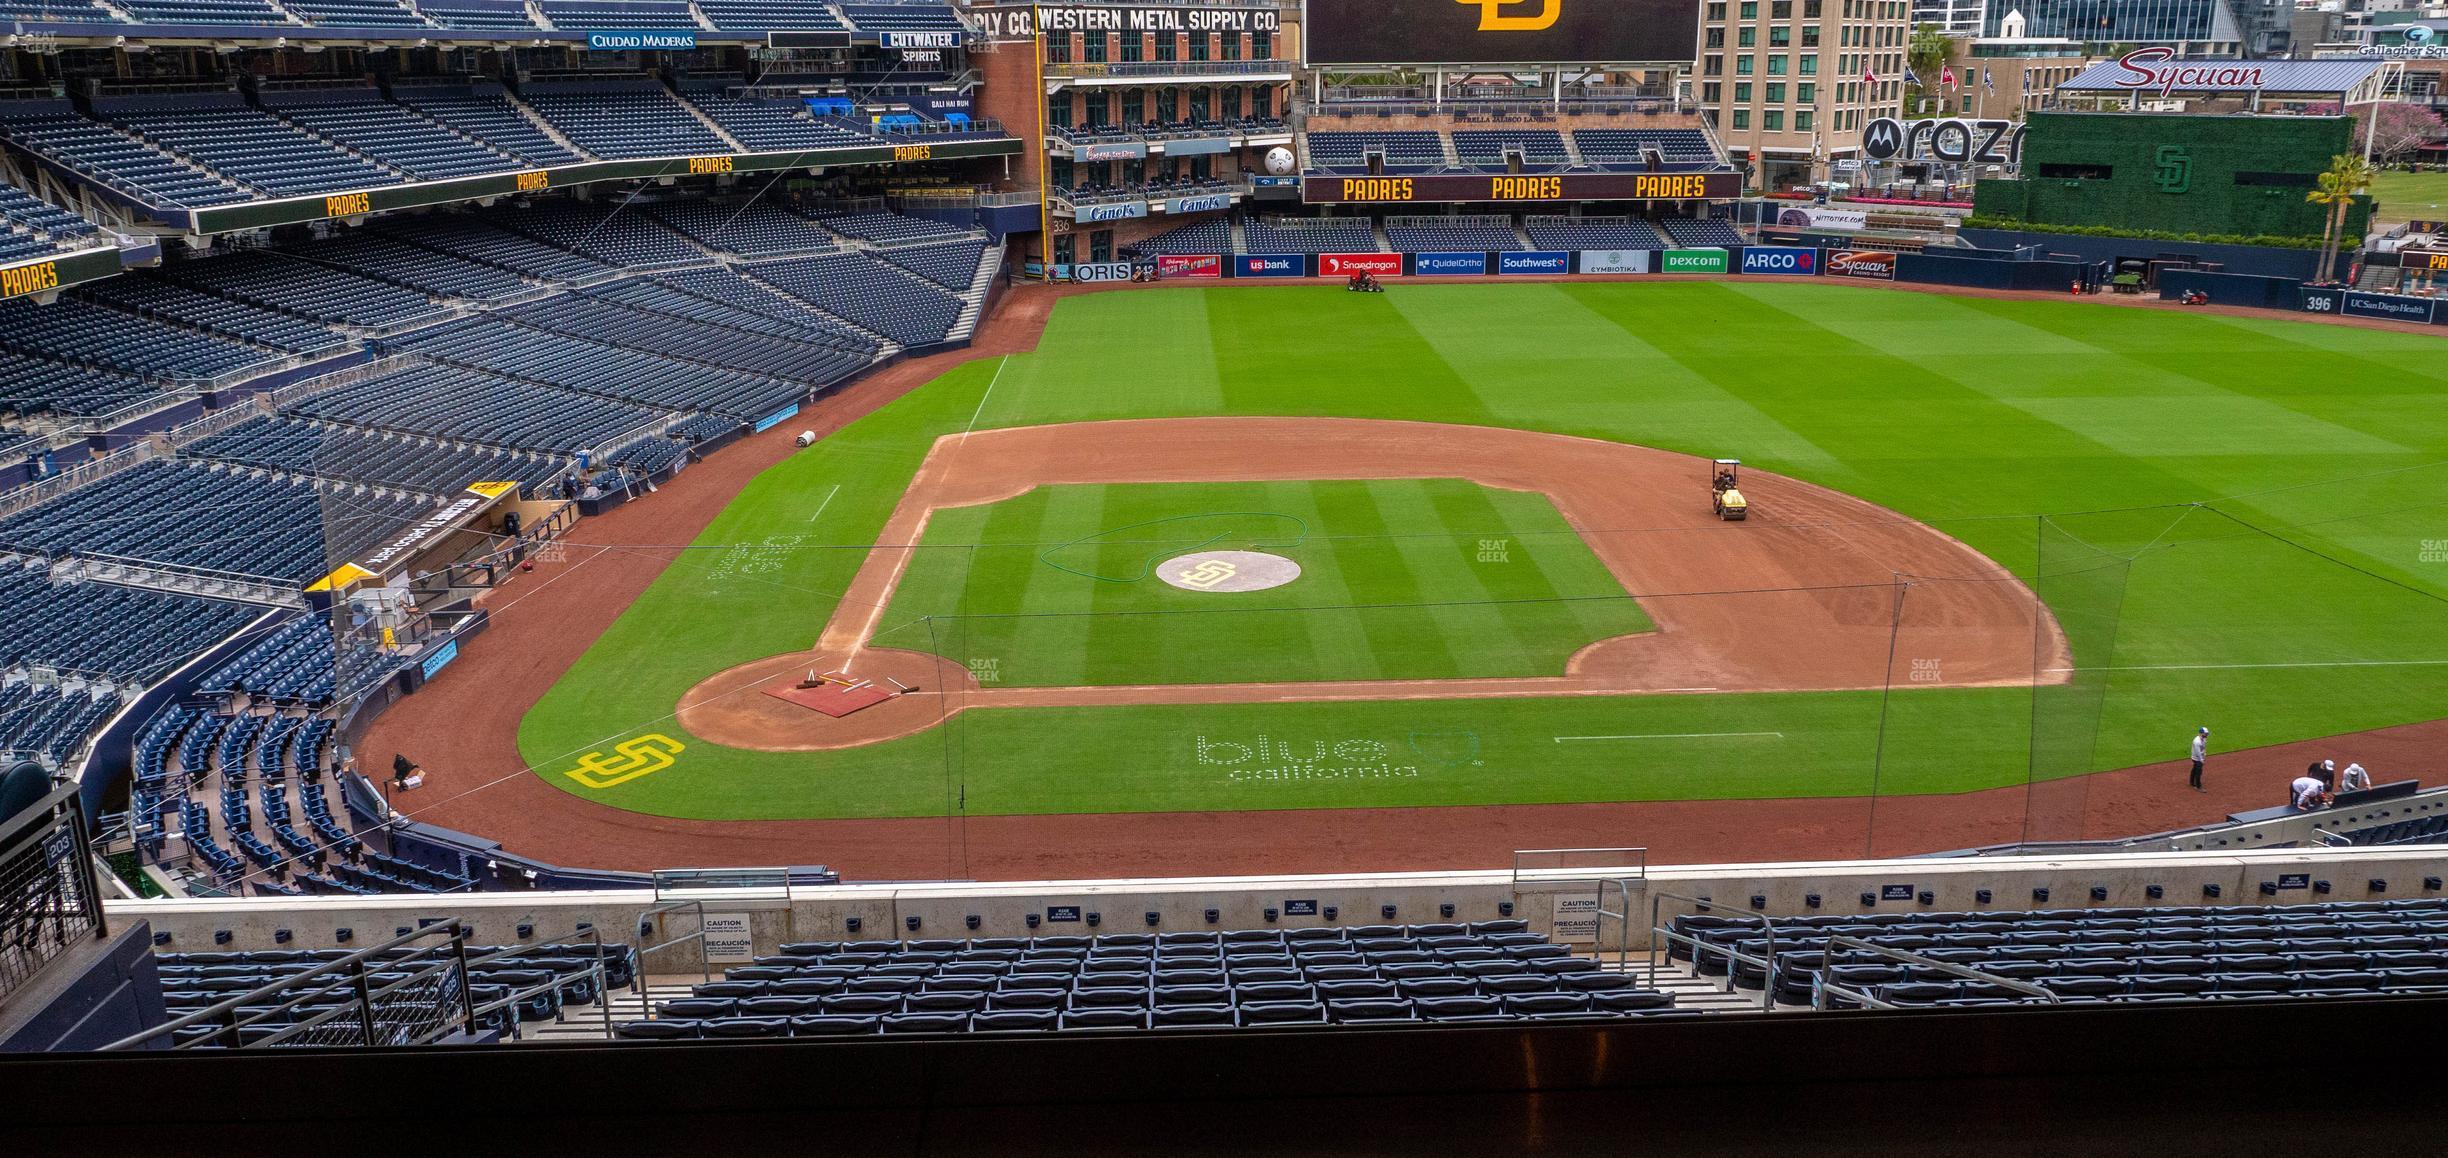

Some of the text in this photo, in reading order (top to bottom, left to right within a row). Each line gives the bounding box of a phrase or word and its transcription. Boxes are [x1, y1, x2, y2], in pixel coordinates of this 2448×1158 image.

[1008, 11, 1035, 36] CO.
[1038, 8, 1279, 30] WESTERN METAL SUPPLY CO.
[591, 34, 693, 47] CIUDAD MADERAS
[890, 33, 953, 47] CUTWATER
[902, 50, 941, 62] SPIRITS
[2358, 45, 2423, 58] Gallagher
[2114, 47, 2268, 99] Sycuan
[894, 145, 931, 161] PADRES
[689, 157, 733, 173] PADRES
[517, 171, 548, 190] PADRES
[1343, 175, 1704, 200] PADRES PADRES PADRES
[326, 192, 370, 217] PADRES
[1053, 219, 1069, 233] 336
[1250, 260, 1290, 269] us bank
[1432, 259, 1483, 269] QuidelOrtho
[1503, 257, 1557, 268] Southwest
[1745, 254, 1795, 269] ARCO
[1830, 252, 1888, 275] Sycuan
[1, 260, 58, 298] PADRES
[1077, 264, 1129, 281] ORIS
[2307, 296, 2331, 311] 396
[2351, 298, 2425, 314] UC San Diego Health
[1197, 734, 1388, 765] blue
[1229, 763, 1418, 780] california
[49, 835, 70, 858] 203
[1554, 919, 1598, 927] PRECAUCIÓ
[444, 975, 458, 998] 205
